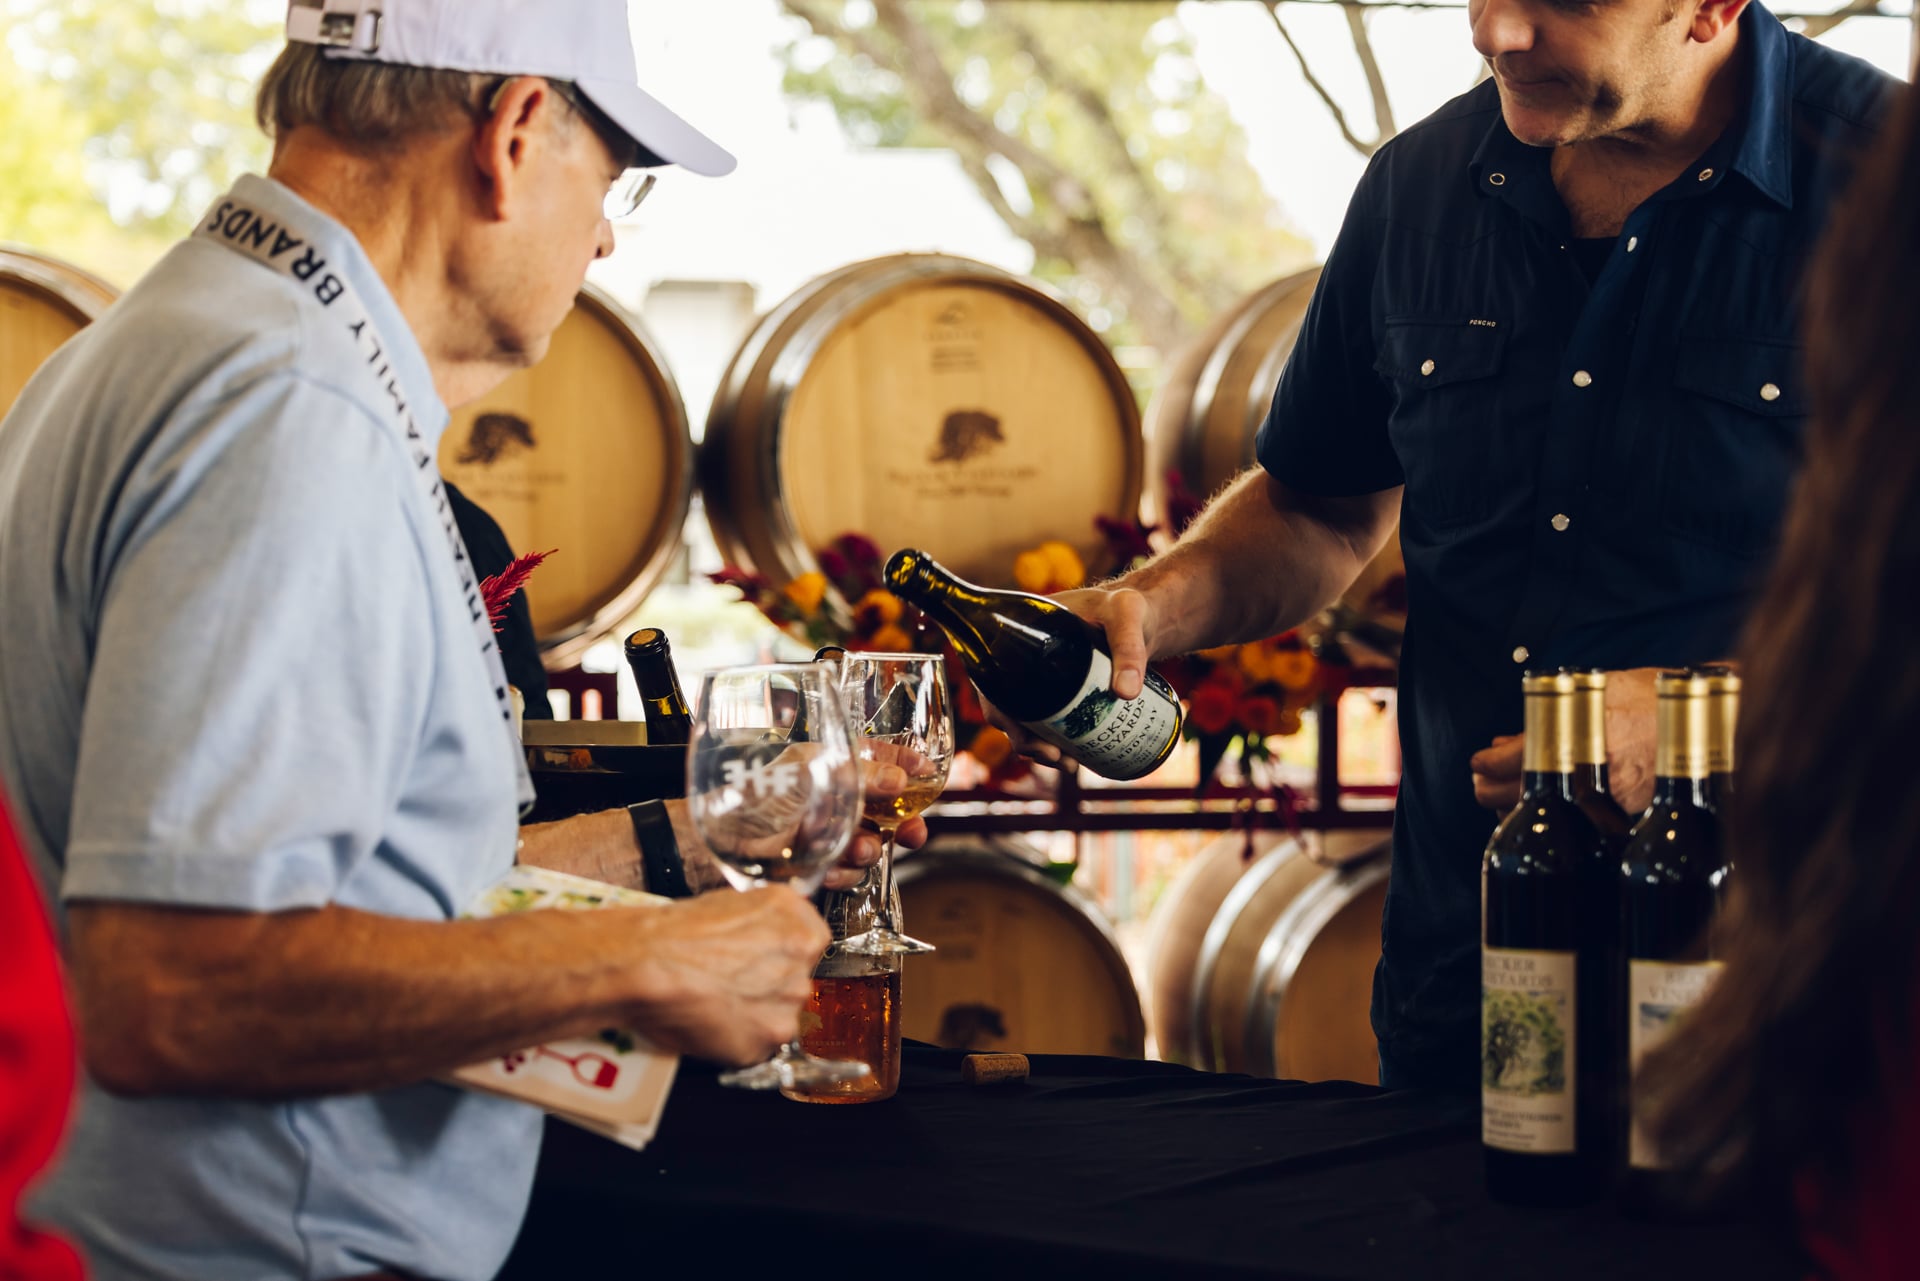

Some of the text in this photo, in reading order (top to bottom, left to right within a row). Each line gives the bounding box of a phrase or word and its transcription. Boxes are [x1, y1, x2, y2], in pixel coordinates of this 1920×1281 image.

[207, 201, 344, 307] BRANDS
[349, 319, 431, 470] FAMILY
[1077, 701, 1133, 753] BECKER
[1083, 697, 1145, 760] INEYARDS
